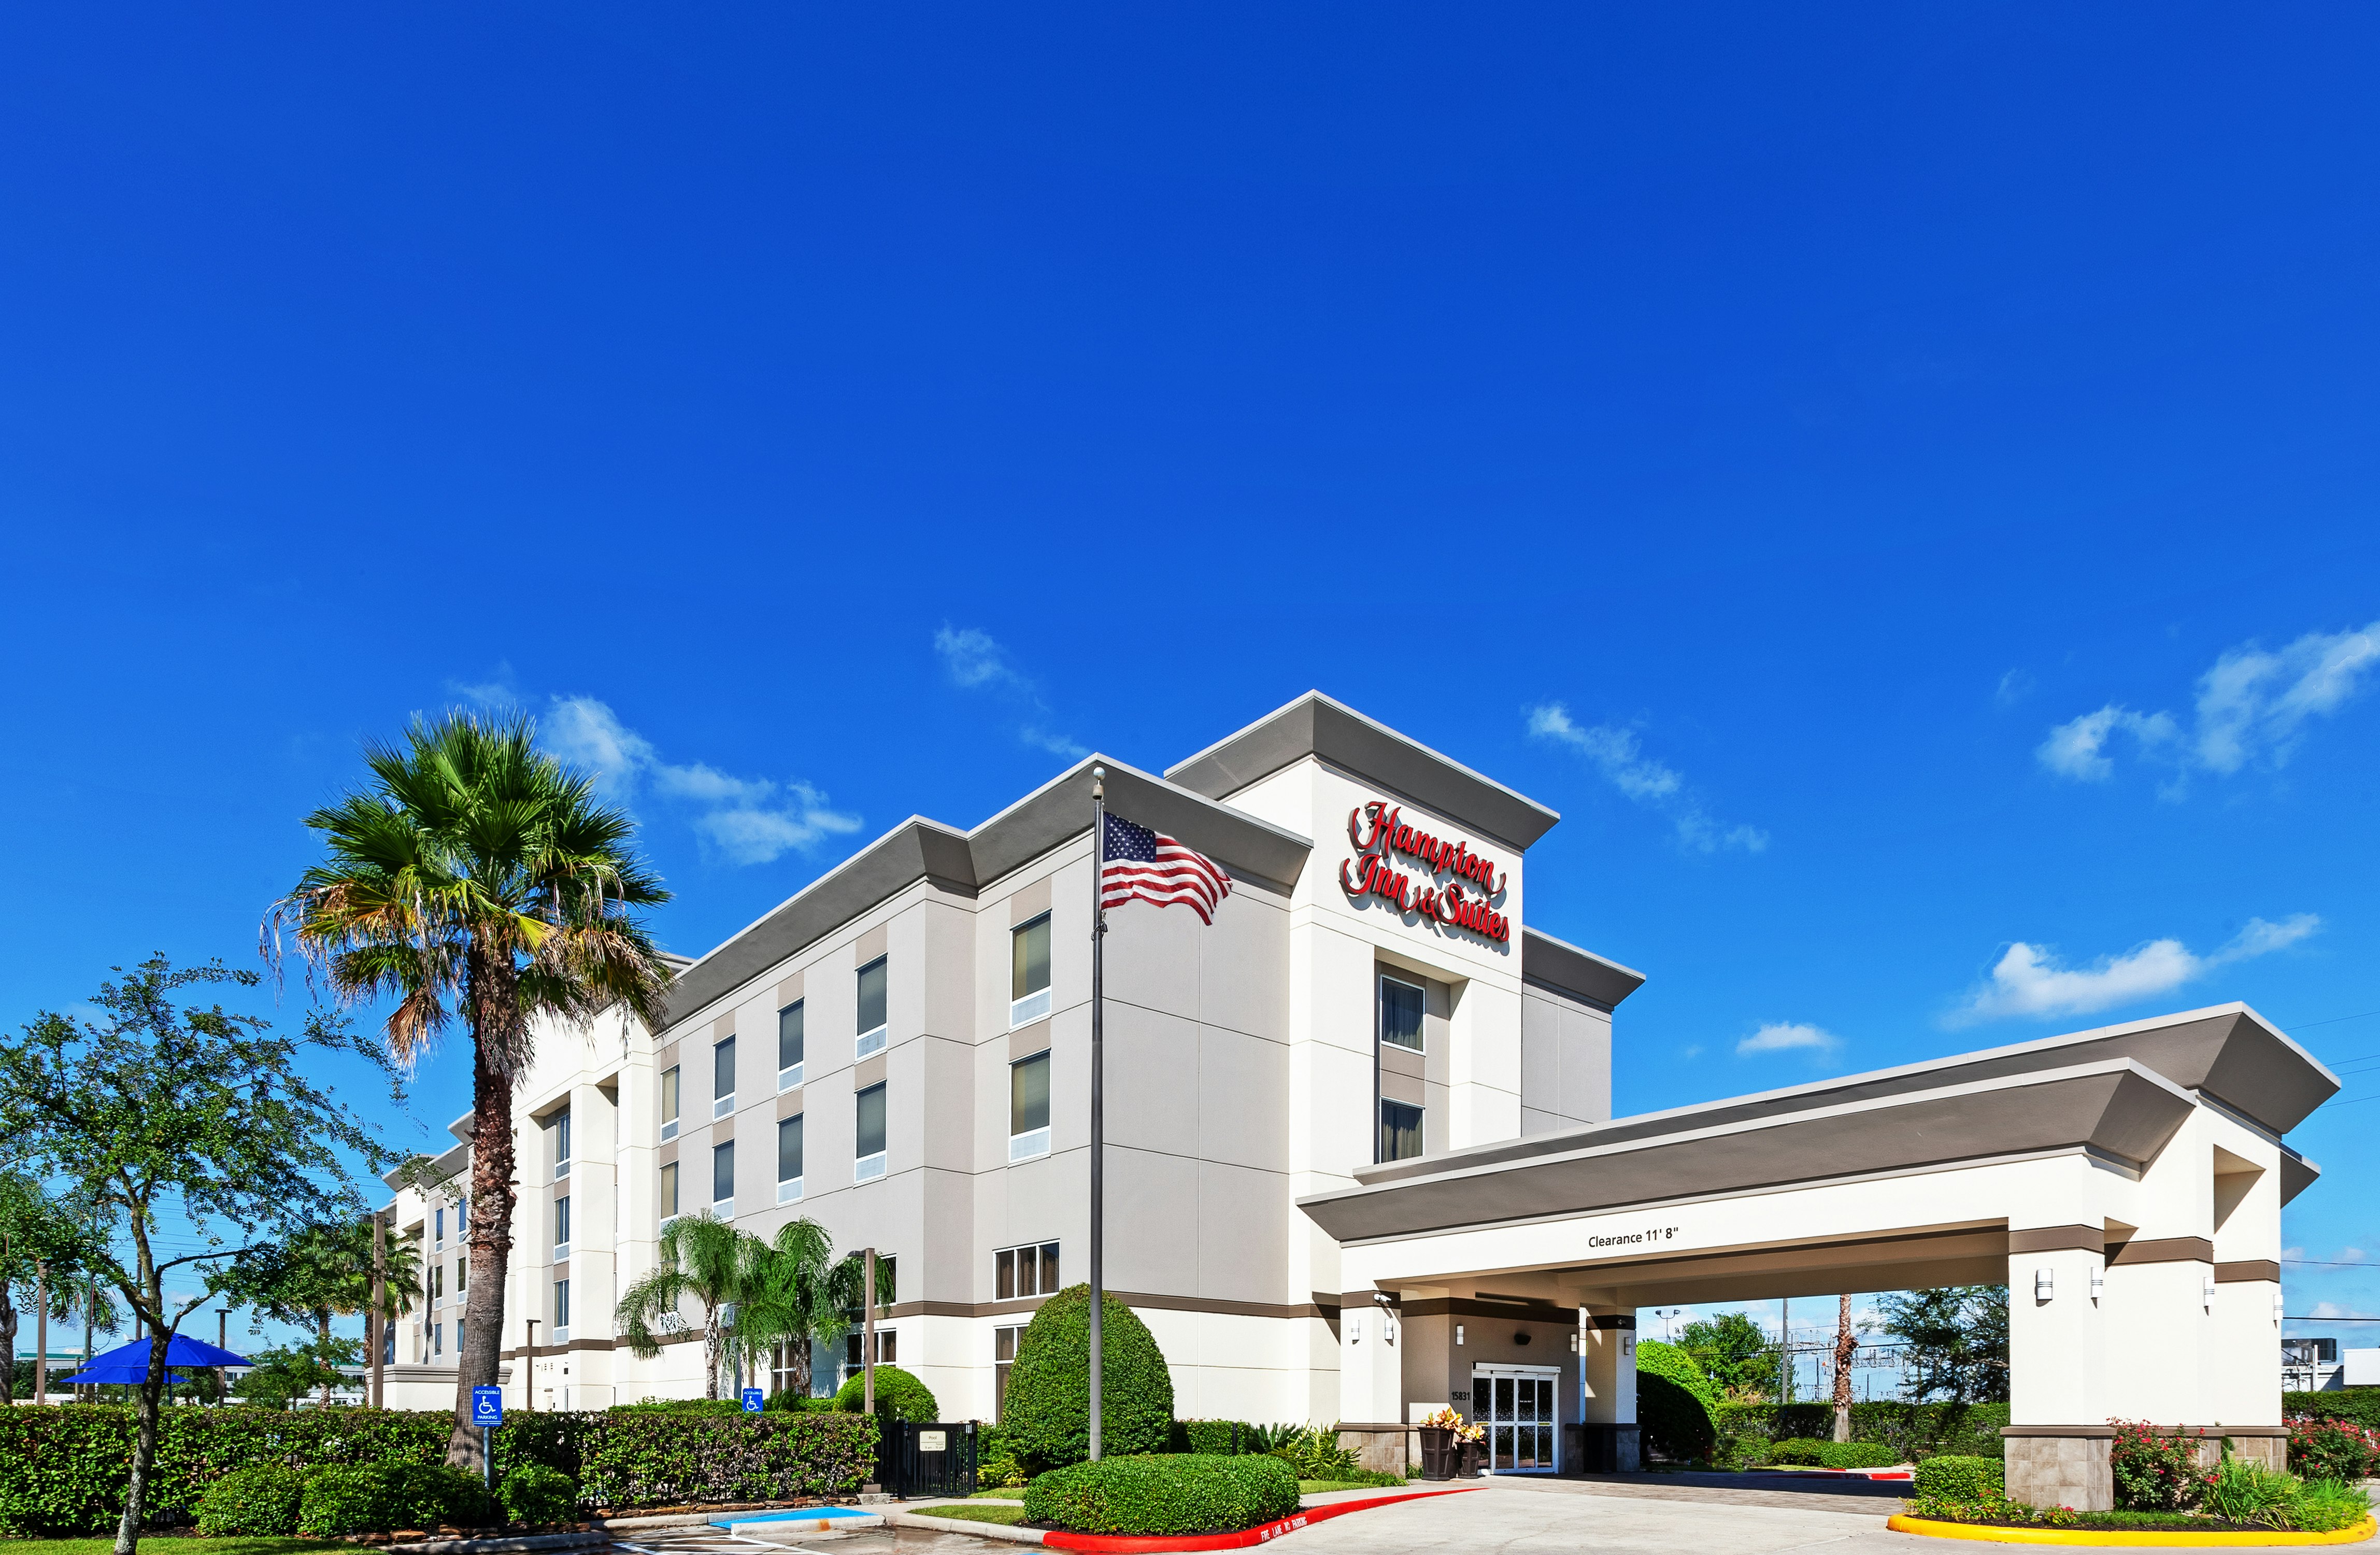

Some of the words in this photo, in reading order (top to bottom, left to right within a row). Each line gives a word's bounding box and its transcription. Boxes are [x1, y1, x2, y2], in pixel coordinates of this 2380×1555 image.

[1348, 801, 1506, 895] Hampton
[1339, 854, 1421, 911] Inn
[1418, 887, 1440, 922] &
[1434, 883, 1510, 942] Suites
[1589, 1234, 1642, 1248] Clearance
[1646, 1229, 1662, 1241] 11'
[1666, 1227, 1678, 1239] 8"
[1451, 1391, 1470, 1401] 15831
[1261, 1529, 1271, 1542] FIRE
[1272, 1524, 1283, 1537] LANE
[1283, 1521, 1291, 1532] NO
[1291, 1516, 1307, 1530] PARKING
